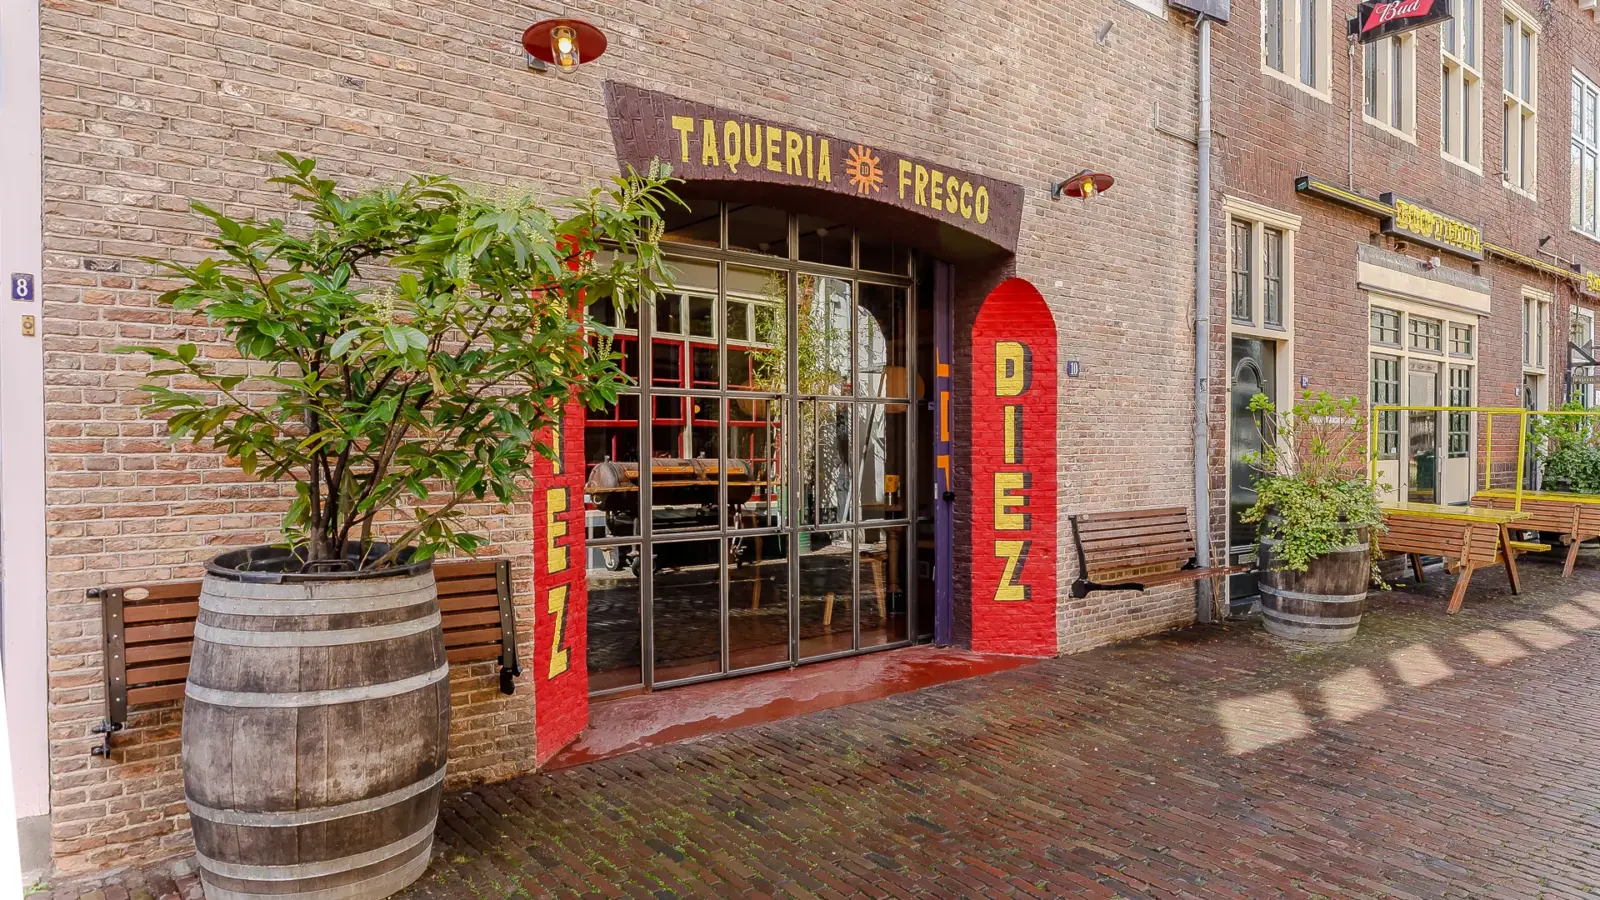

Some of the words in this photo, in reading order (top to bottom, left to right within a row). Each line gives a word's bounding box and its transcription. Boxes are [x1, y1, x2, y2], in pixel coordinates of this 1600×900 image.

[1376, 0, 1421, 23] Bud
[671, 115, 832, 183] TAQUERIA
[898, 159, 990, 225] FRESCO
[16, 278, 28, 297] 8
[1070, 361, 1078, 375] 10
[994, 341, 1032, 601] DIEZ
